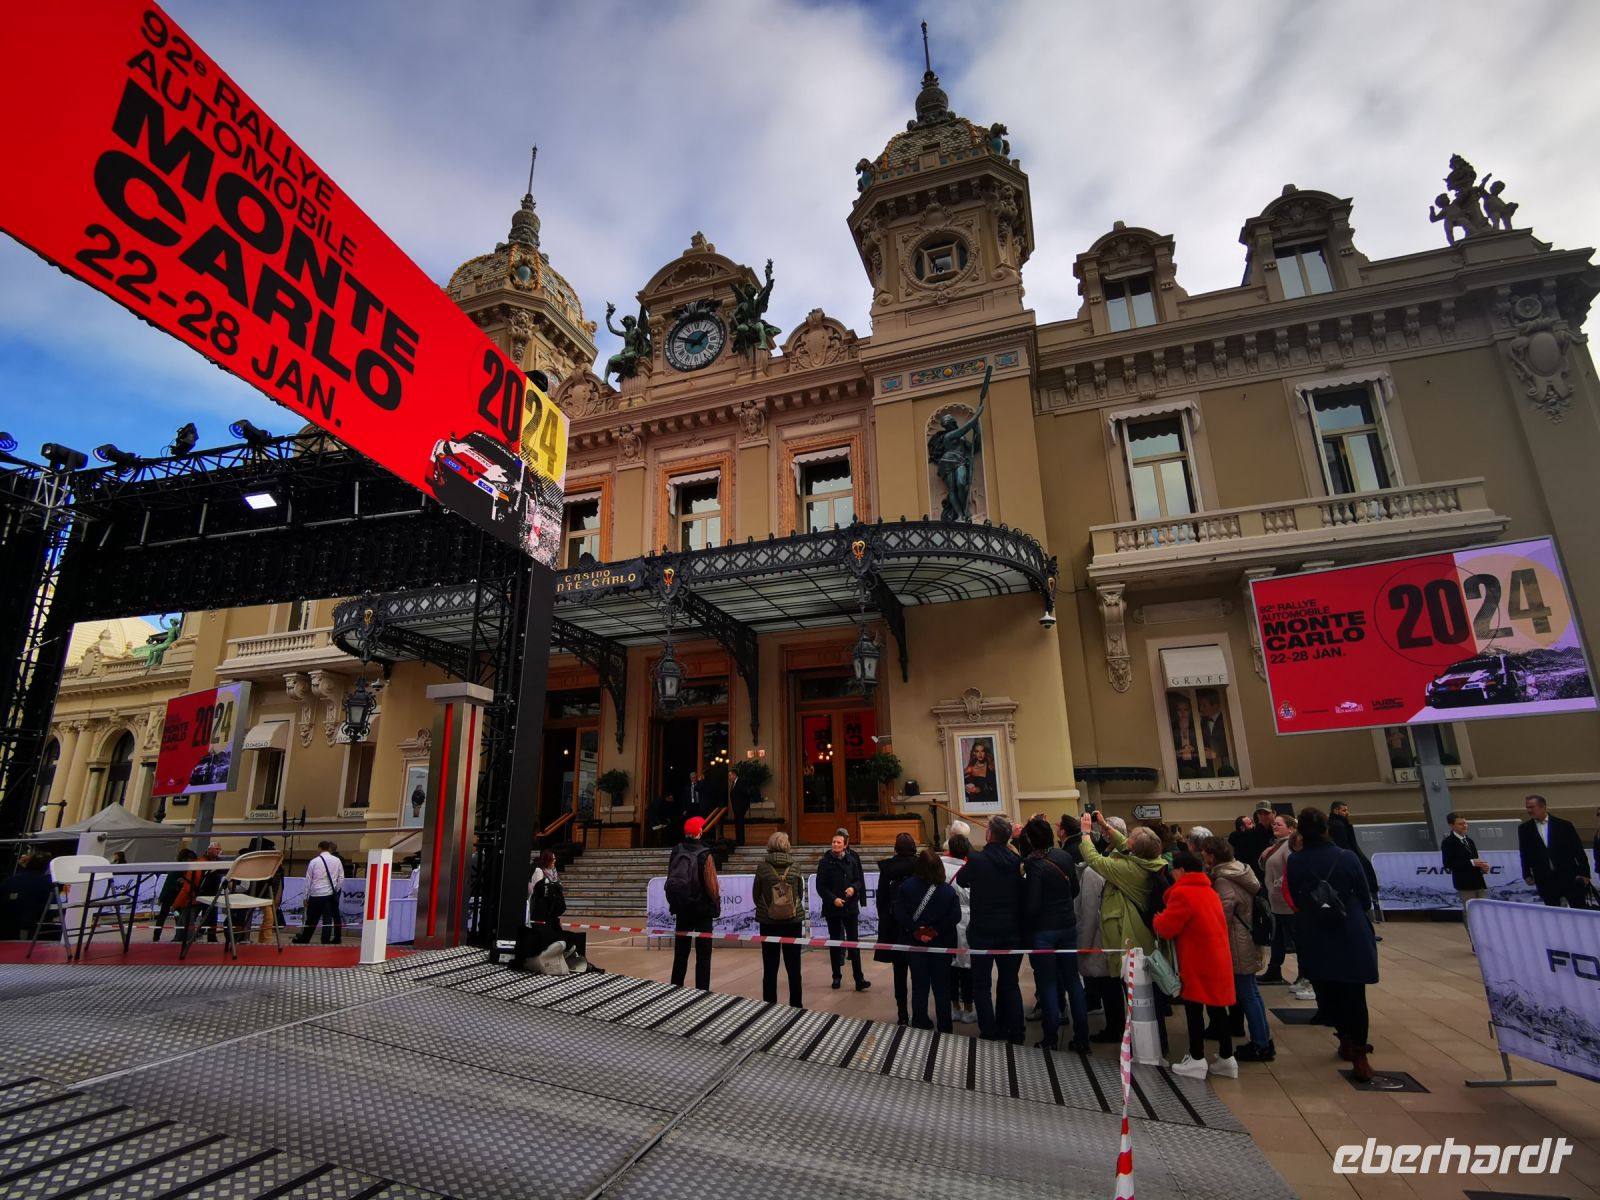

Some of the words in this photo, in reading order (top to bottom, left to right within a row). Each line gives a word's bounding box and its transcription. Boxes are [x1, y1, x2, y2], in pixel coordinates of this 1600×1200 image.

[213, 79, 335, 210] RALLYE
[127, 50, 357, 265] AUTOMOBILE
[112, 78, 419, 374] MONTE
[94, 150, 402, 411] CARLO
[75, 224, 239, 355] 22-28
[251, 345, 341, 427] JAN.
[556, 573, 636, 592] NTE-CARLO
[565, 570, 611, 582] CASINO
[1261, 606, 1330, 622] AUTOMOBILE
[1277, 599, 1317, 611] RALLYE
[1388, 568, 1552, 649] 2024
[1263, 611, 1366, 636] MONTE
[1266, 626, 1365, 651] CARLO
[1270, 650, 1308, 664] 22-28
[1312, 647, 1347, 660] JAN.
[1171, 674, 1225, 686] GRAFF
[192, 701, 234, 747] 2024
[1184, 780, 1236, 791] GRAFF
[1416, 866, 1502, 875] FANC
[720, 895, 743, 905] INO
